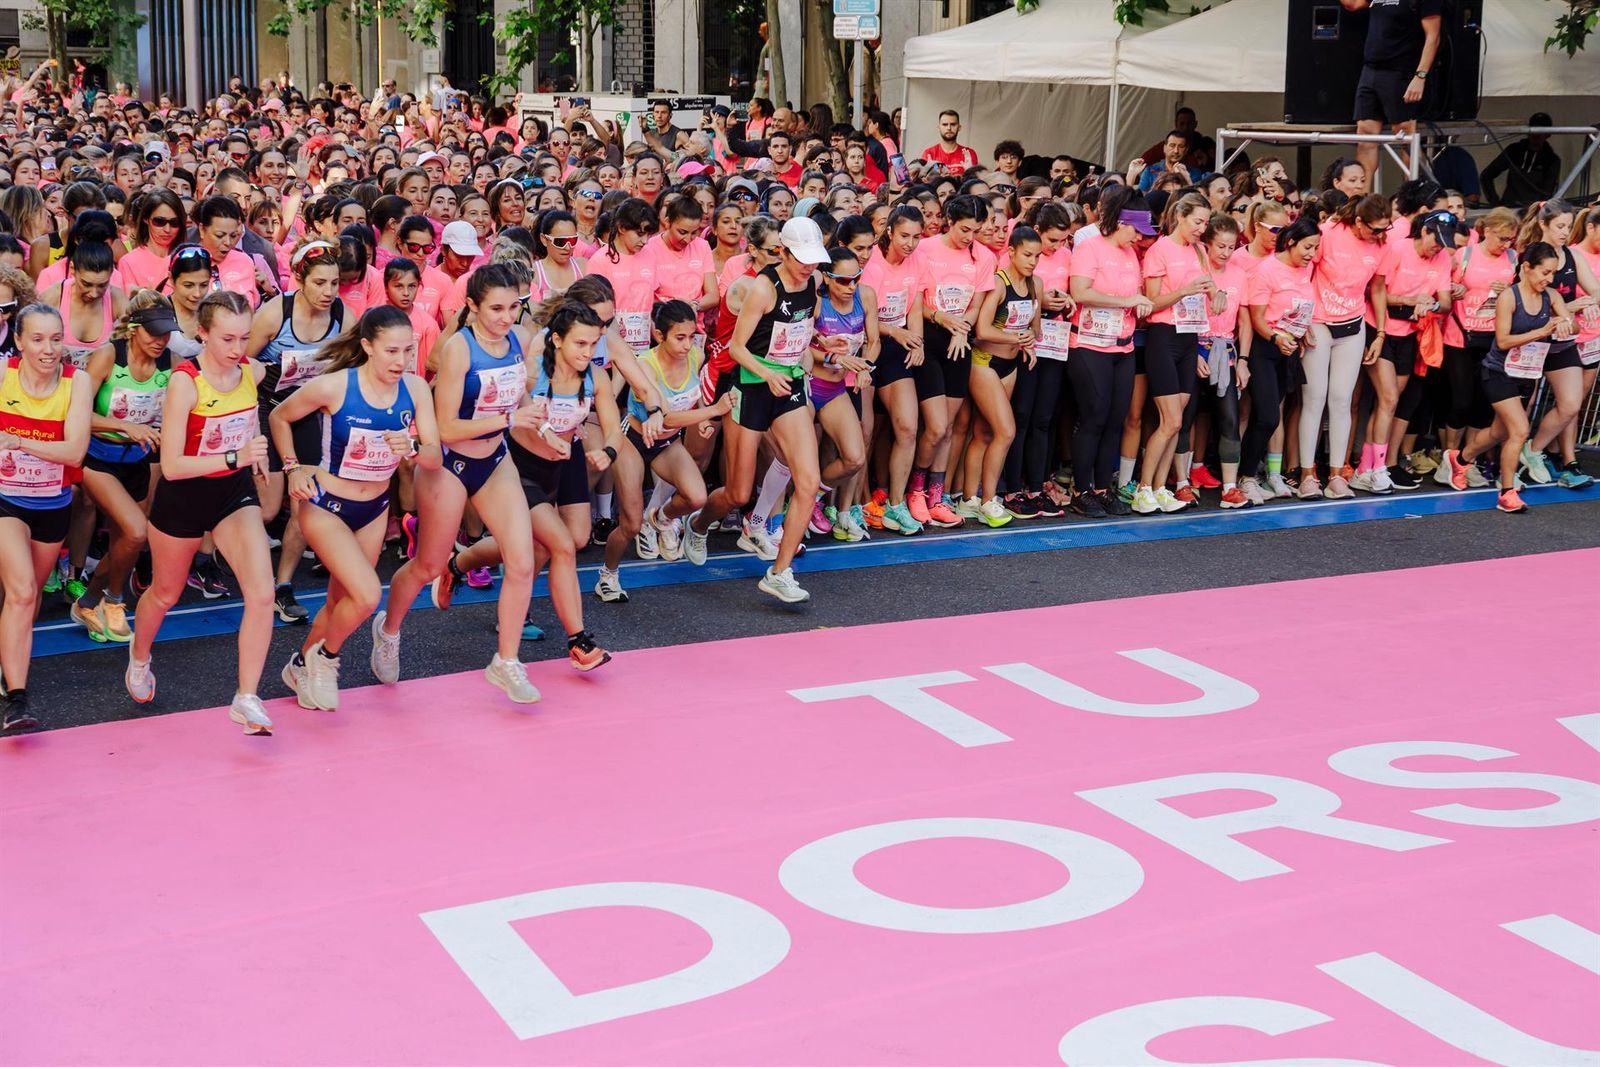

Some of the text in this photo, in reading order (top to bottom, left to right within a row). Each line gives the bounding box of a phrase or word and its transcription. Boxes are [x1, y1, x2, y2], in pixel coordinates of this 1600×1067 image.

[1468, 295, 1480, 304] TU
[500, 388, 516, 398] 016
[129, 409, 148, 417] 016
[9, 426, 31, 436] Casa
[32, 429, 55, 439] Rural
[368, 450, 389, 458] 016
[19, 467, 42, 476] 016
[787, 648, 1260, 748] TU
